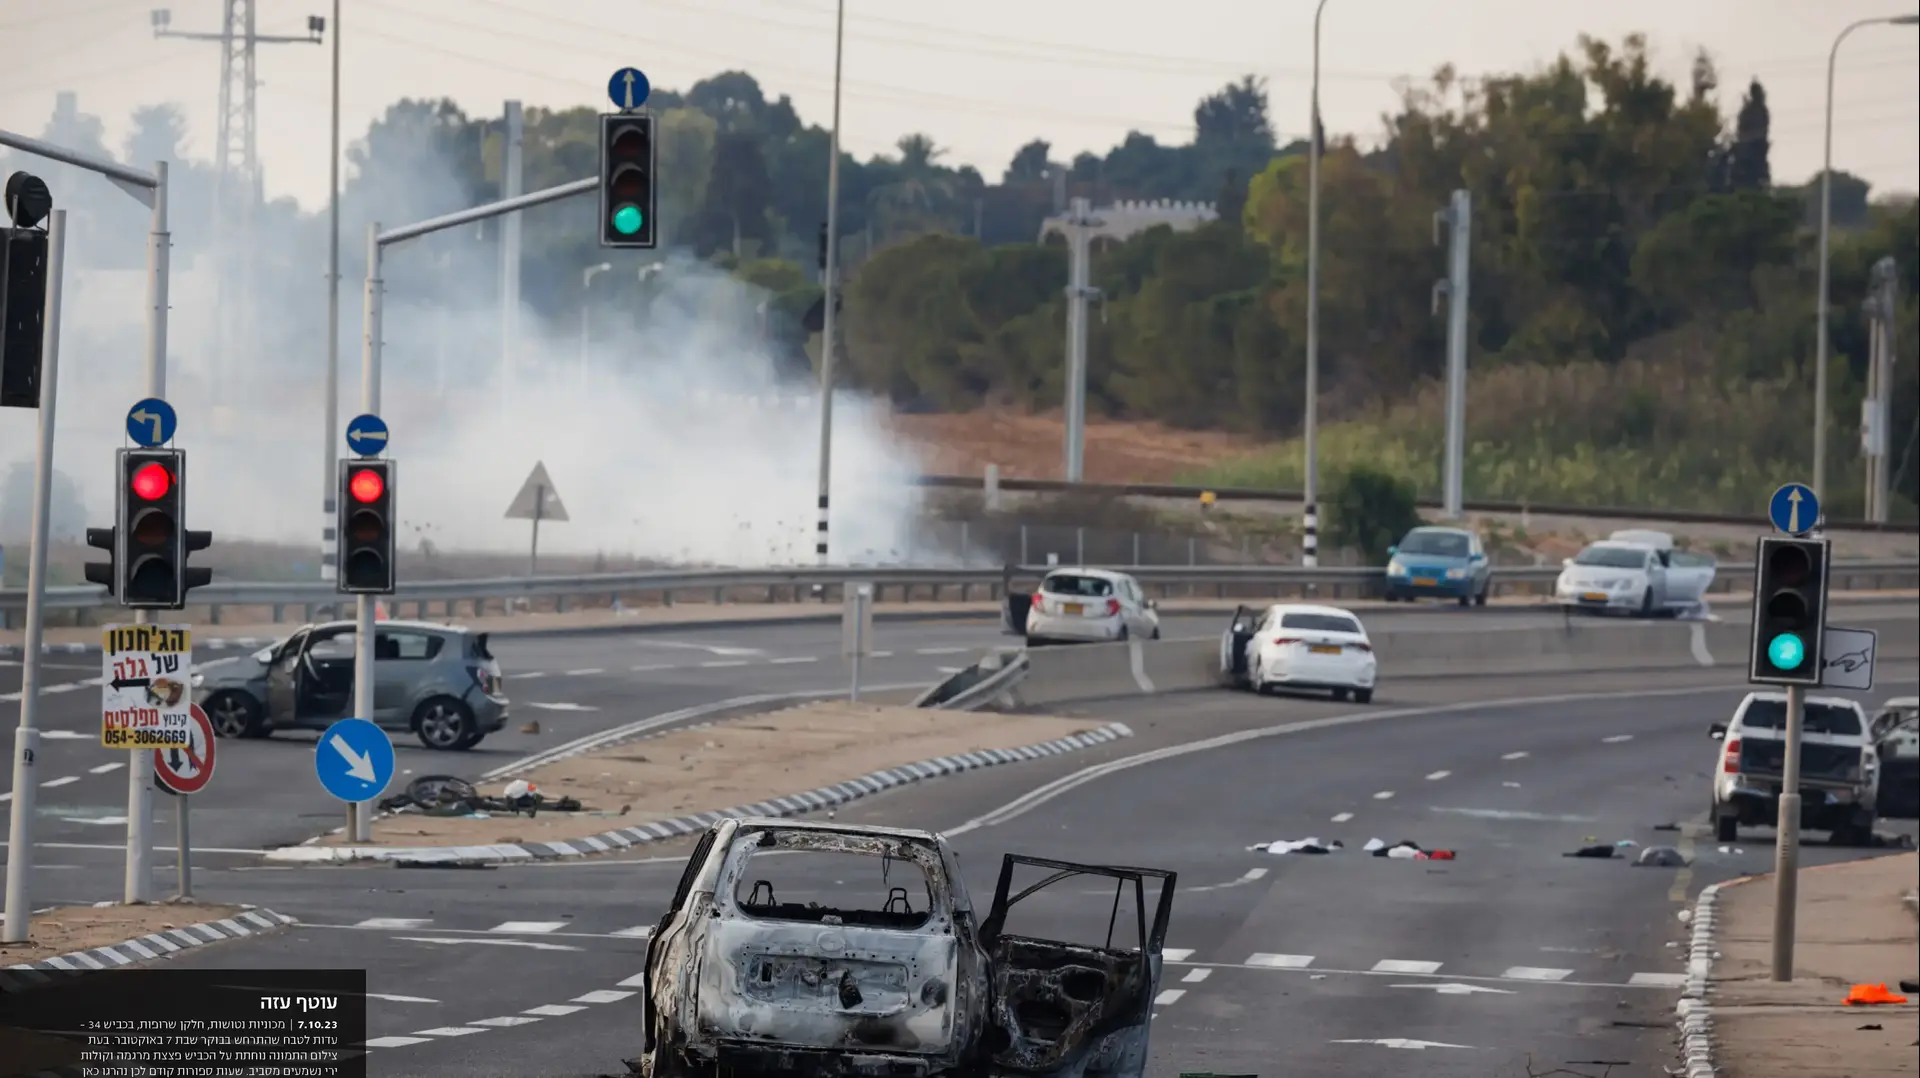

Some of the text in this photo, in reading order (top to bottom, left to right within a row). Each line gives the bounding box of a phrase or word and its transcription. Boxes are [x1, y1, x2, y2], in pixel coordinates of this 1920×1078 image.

[110, 626, 184, 656] הג'חנון
[113, 653, 179, 679] של גלה
[104, 707, 187, 729] קיבוץ מפלסים
[105, 730, 187, 744] 054-3062669
